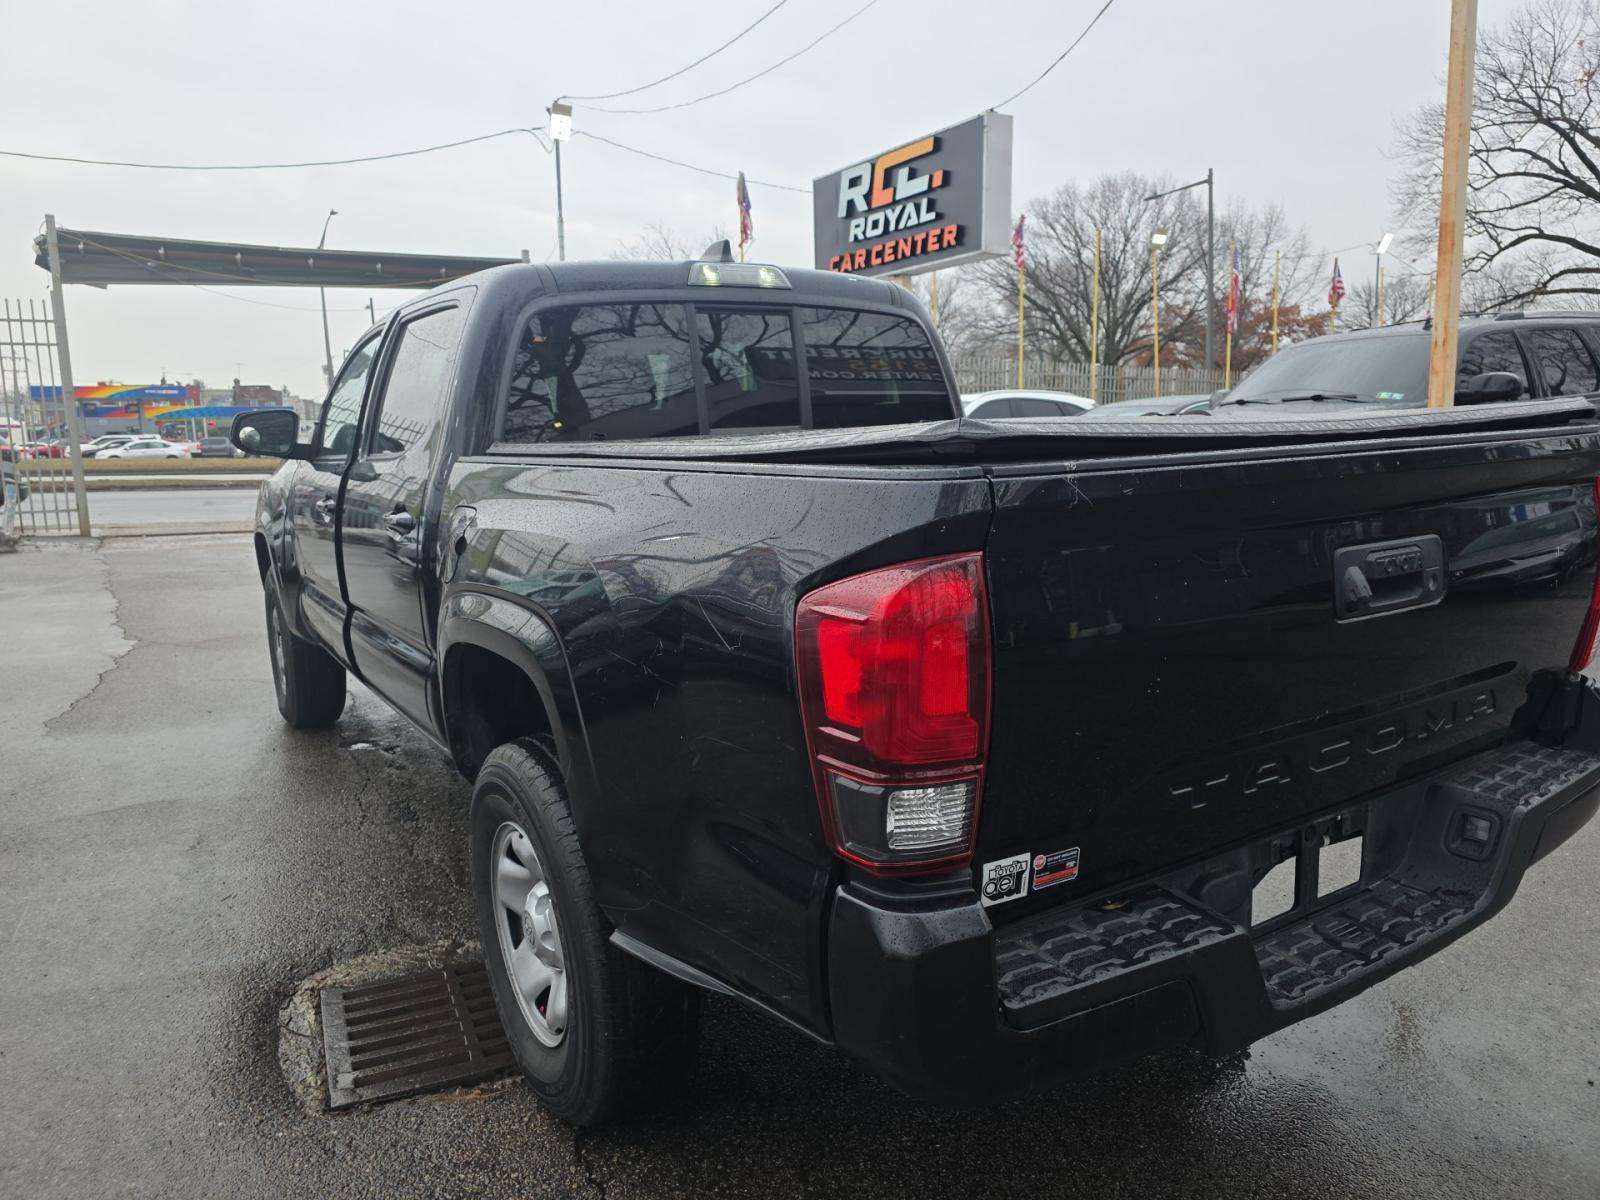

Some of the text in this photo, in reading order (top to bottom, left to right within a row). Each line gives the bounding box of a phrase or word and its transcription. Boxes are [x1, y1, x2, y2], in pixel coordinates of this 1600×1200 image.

[849, 197, 936, 242] ROYAL
[829, 224, 958, 270] CAR CENTER
[1169, 687, 1496, 809] TACOMA
[989, 861, 1027, 880] TOYOTA
